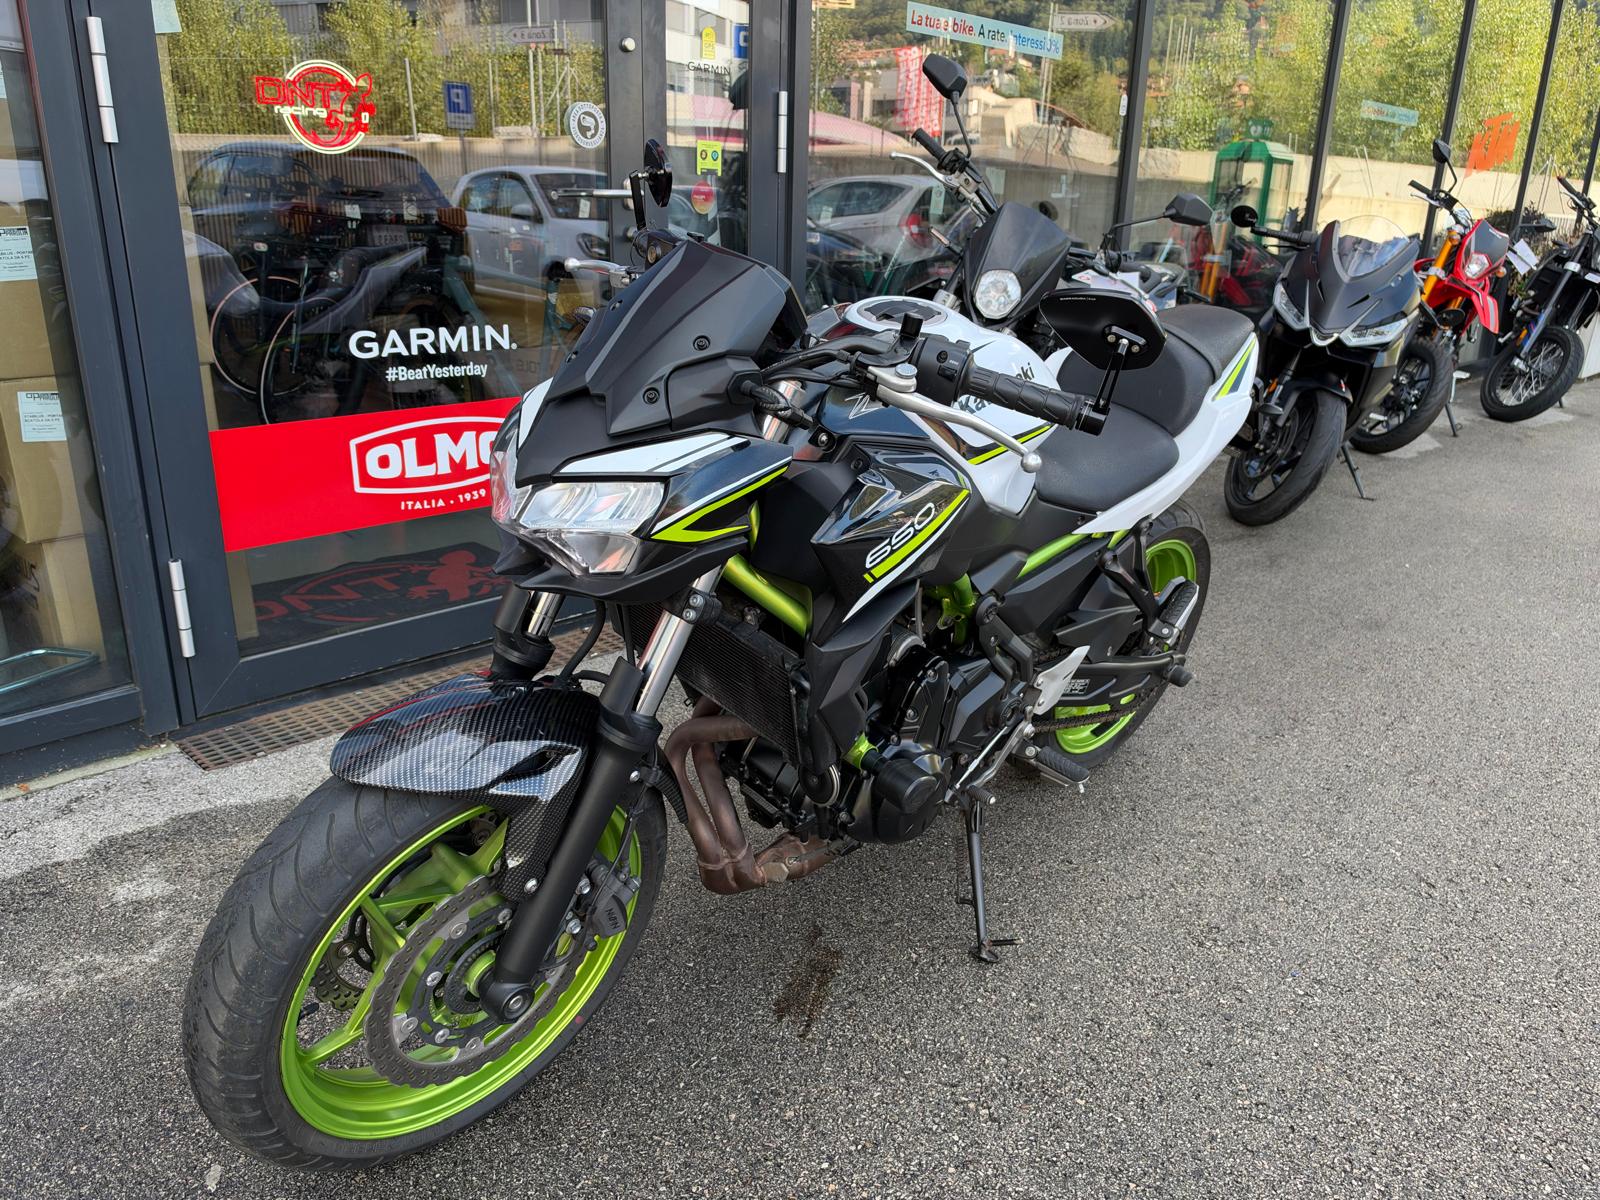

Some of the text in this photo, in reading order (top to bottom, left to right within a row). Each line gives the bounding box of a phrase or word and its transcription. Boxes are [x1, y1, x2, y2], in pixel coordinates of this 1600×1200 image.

[911, 10, 923, 26] La
[925, 14, 941, 29] tua
[943, 17, 976, 37] ebike.
[978, 24, 985, 38] A
[987, 28, 1008, 43] rate.
[687, 61, 731, 77] GARMIN
[274, 105, 328, 119] racing
[1466, 113, 1520, 178] KTM
[385, 361, 488, 382] #BeatYesterday
[401, 488, 487, 510] ITALIA 1939
[865, 502, 936, 569] 650
